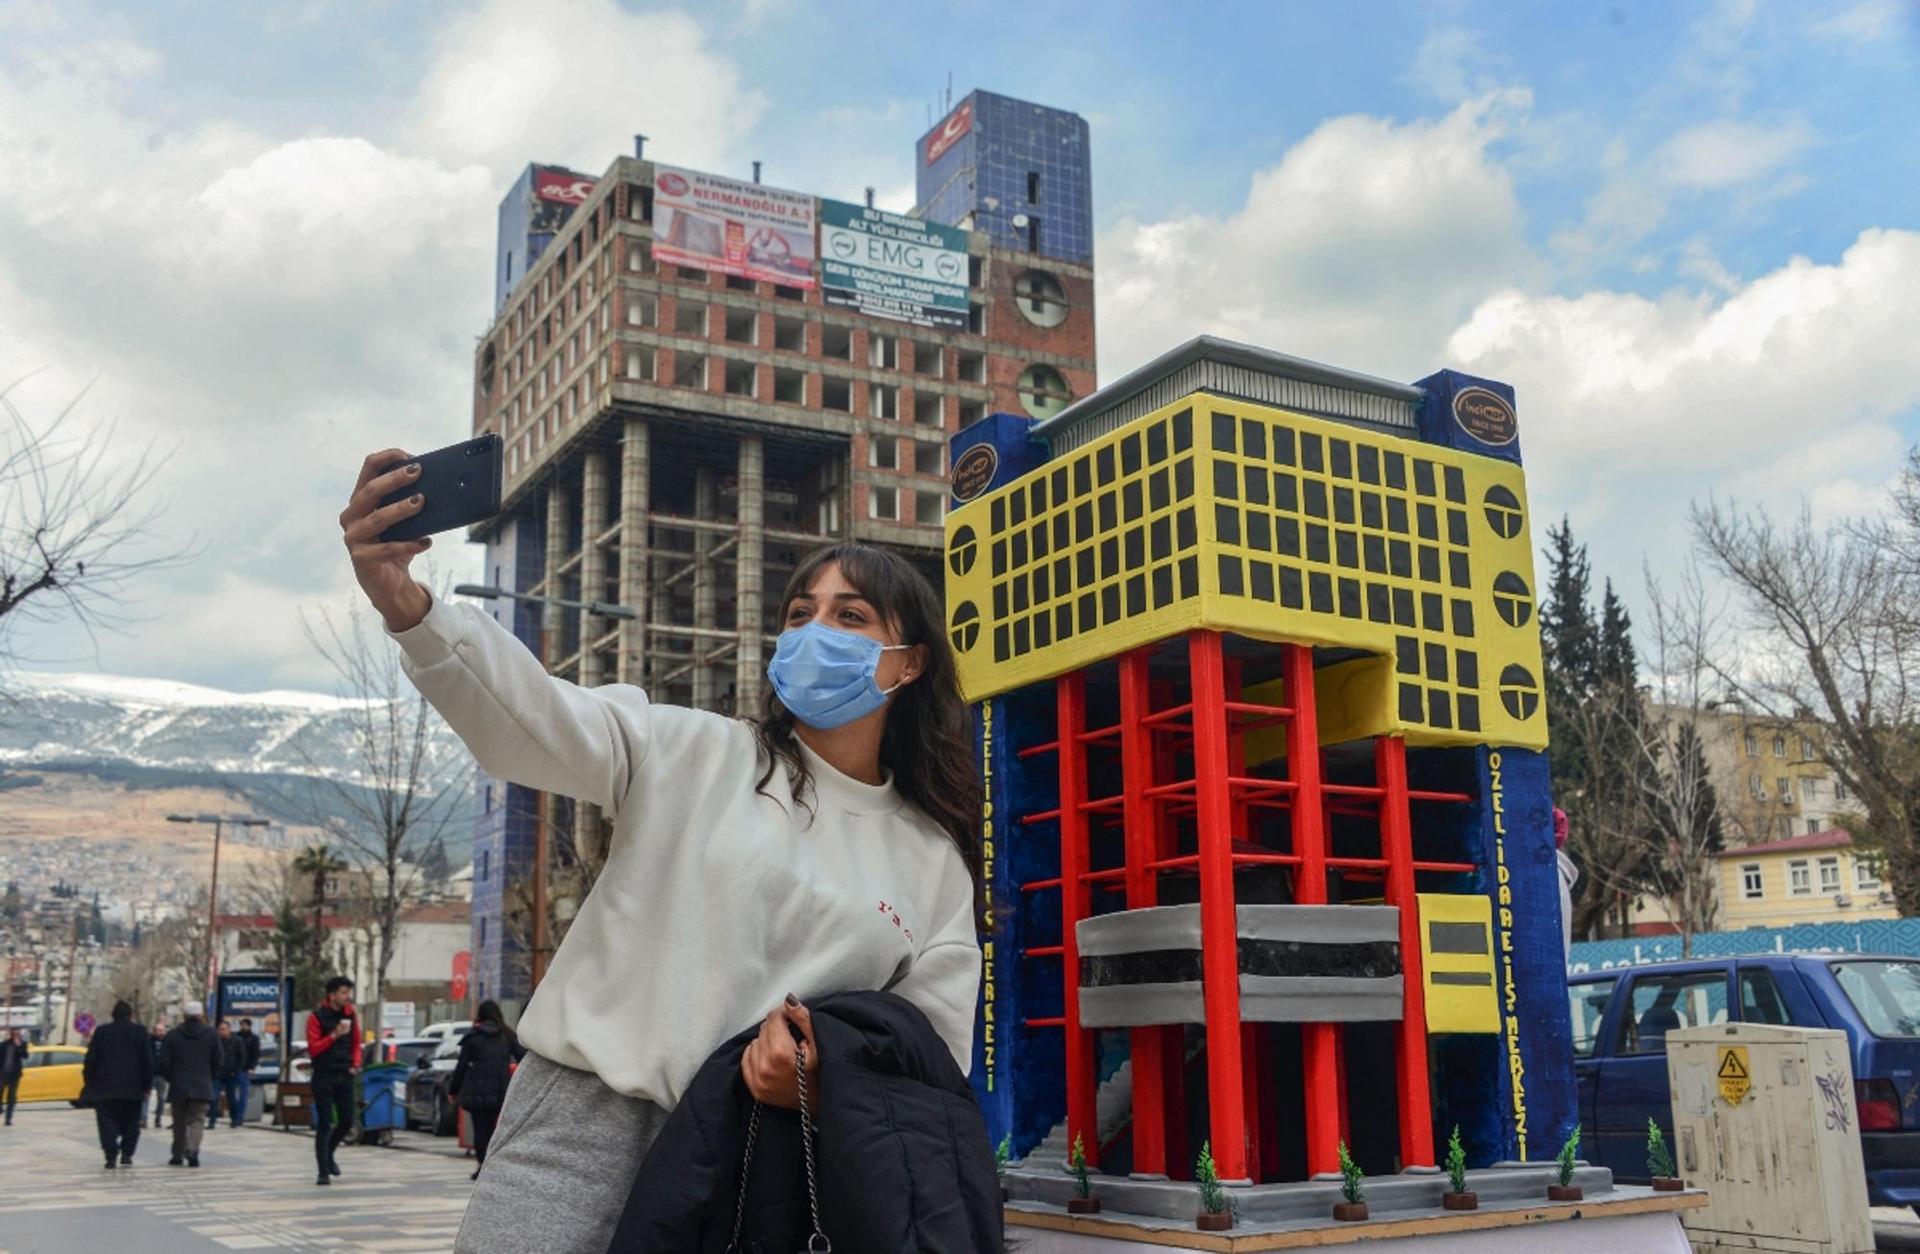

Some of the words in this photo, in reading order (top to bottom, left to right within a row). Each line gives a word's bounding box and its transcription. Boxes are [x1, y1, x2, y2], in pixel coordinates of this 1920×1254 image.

[848, 218, 867, 232] ALT
[867, 237, 924, 270] EMG
[983, 777, 994, 879] İDARE
[1496, 838, 1514, 952] İDARE
[983, 941, 995, 1092] MERKEZİ
[1506, 1015, 1528, 1162] MERKEZİ
